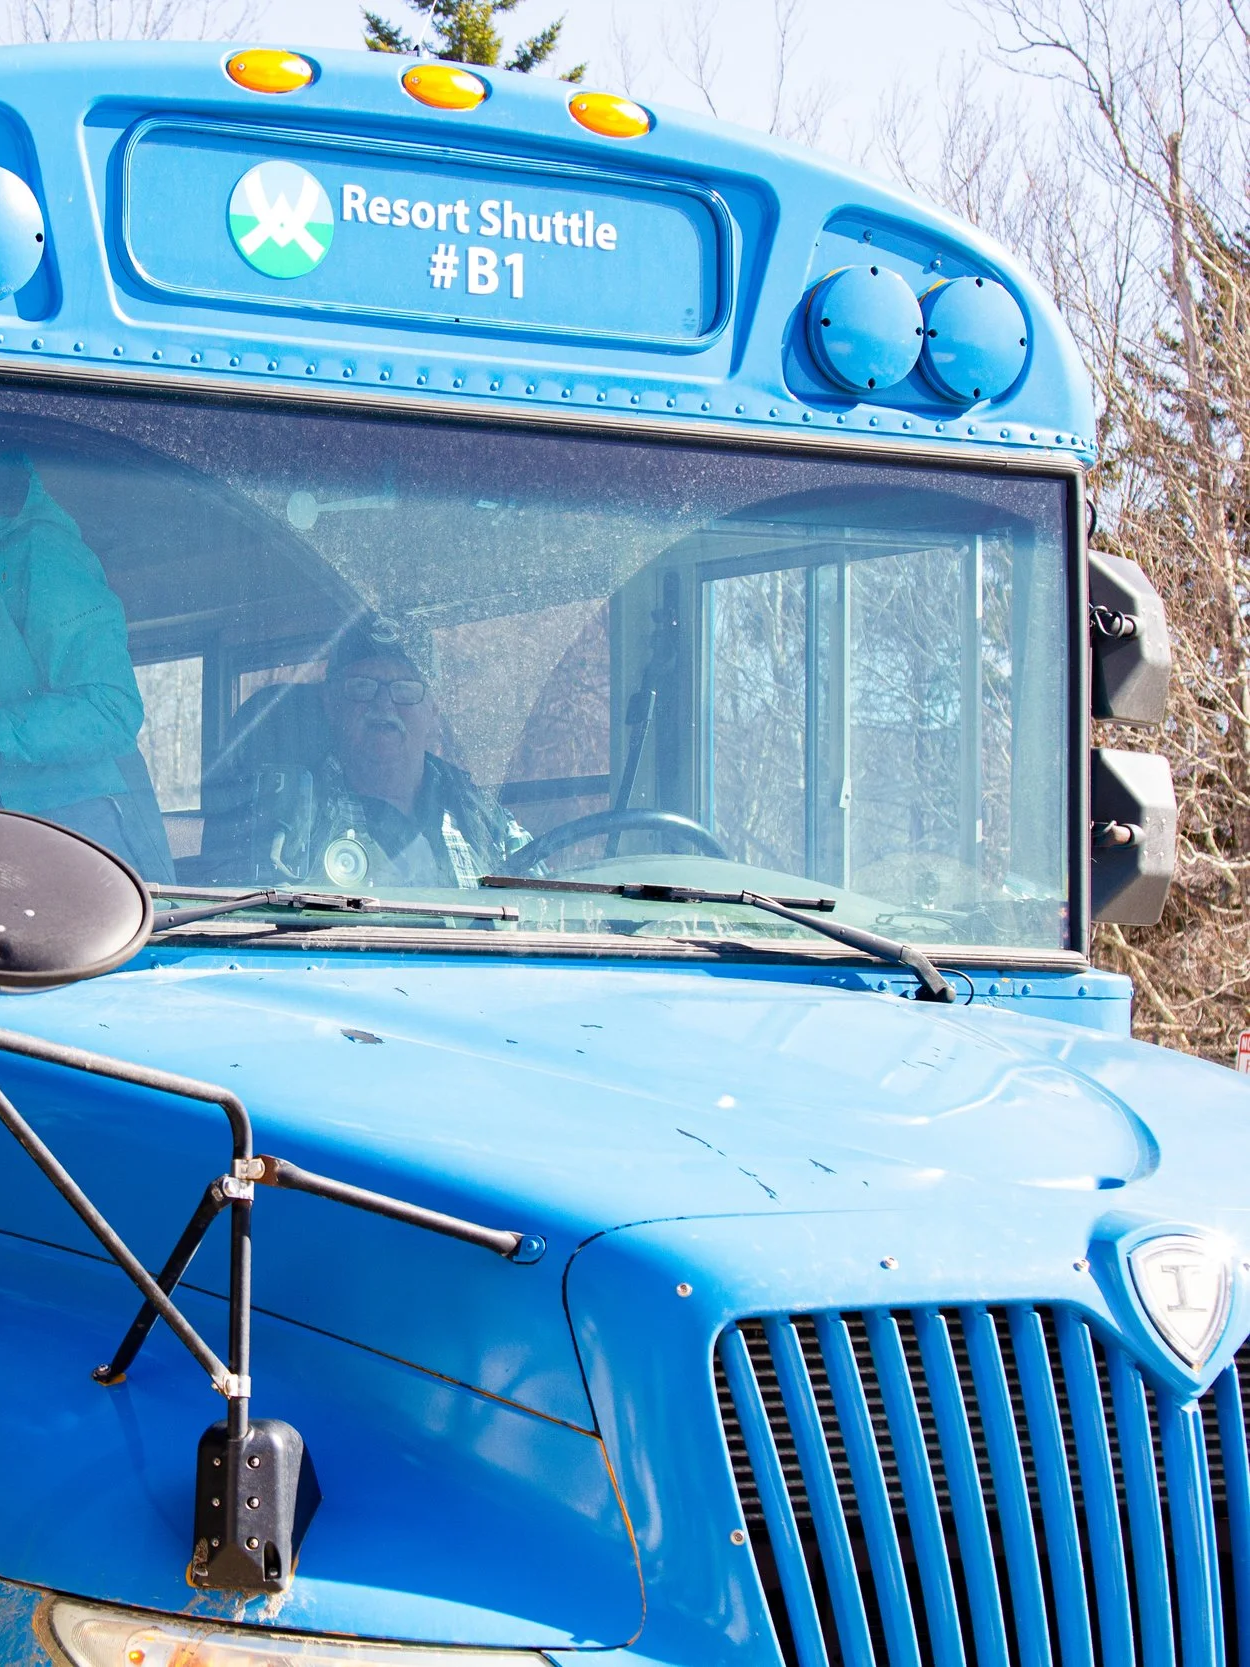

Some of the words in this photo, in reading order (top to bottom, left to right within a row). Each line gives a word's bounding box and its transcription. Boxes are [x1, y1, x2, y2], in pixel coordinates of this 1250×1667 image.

[341, 184, 470, 233] Resort
[479, 199, 618, 250] Shuttle
[429, 243, 525, 298] #B1
